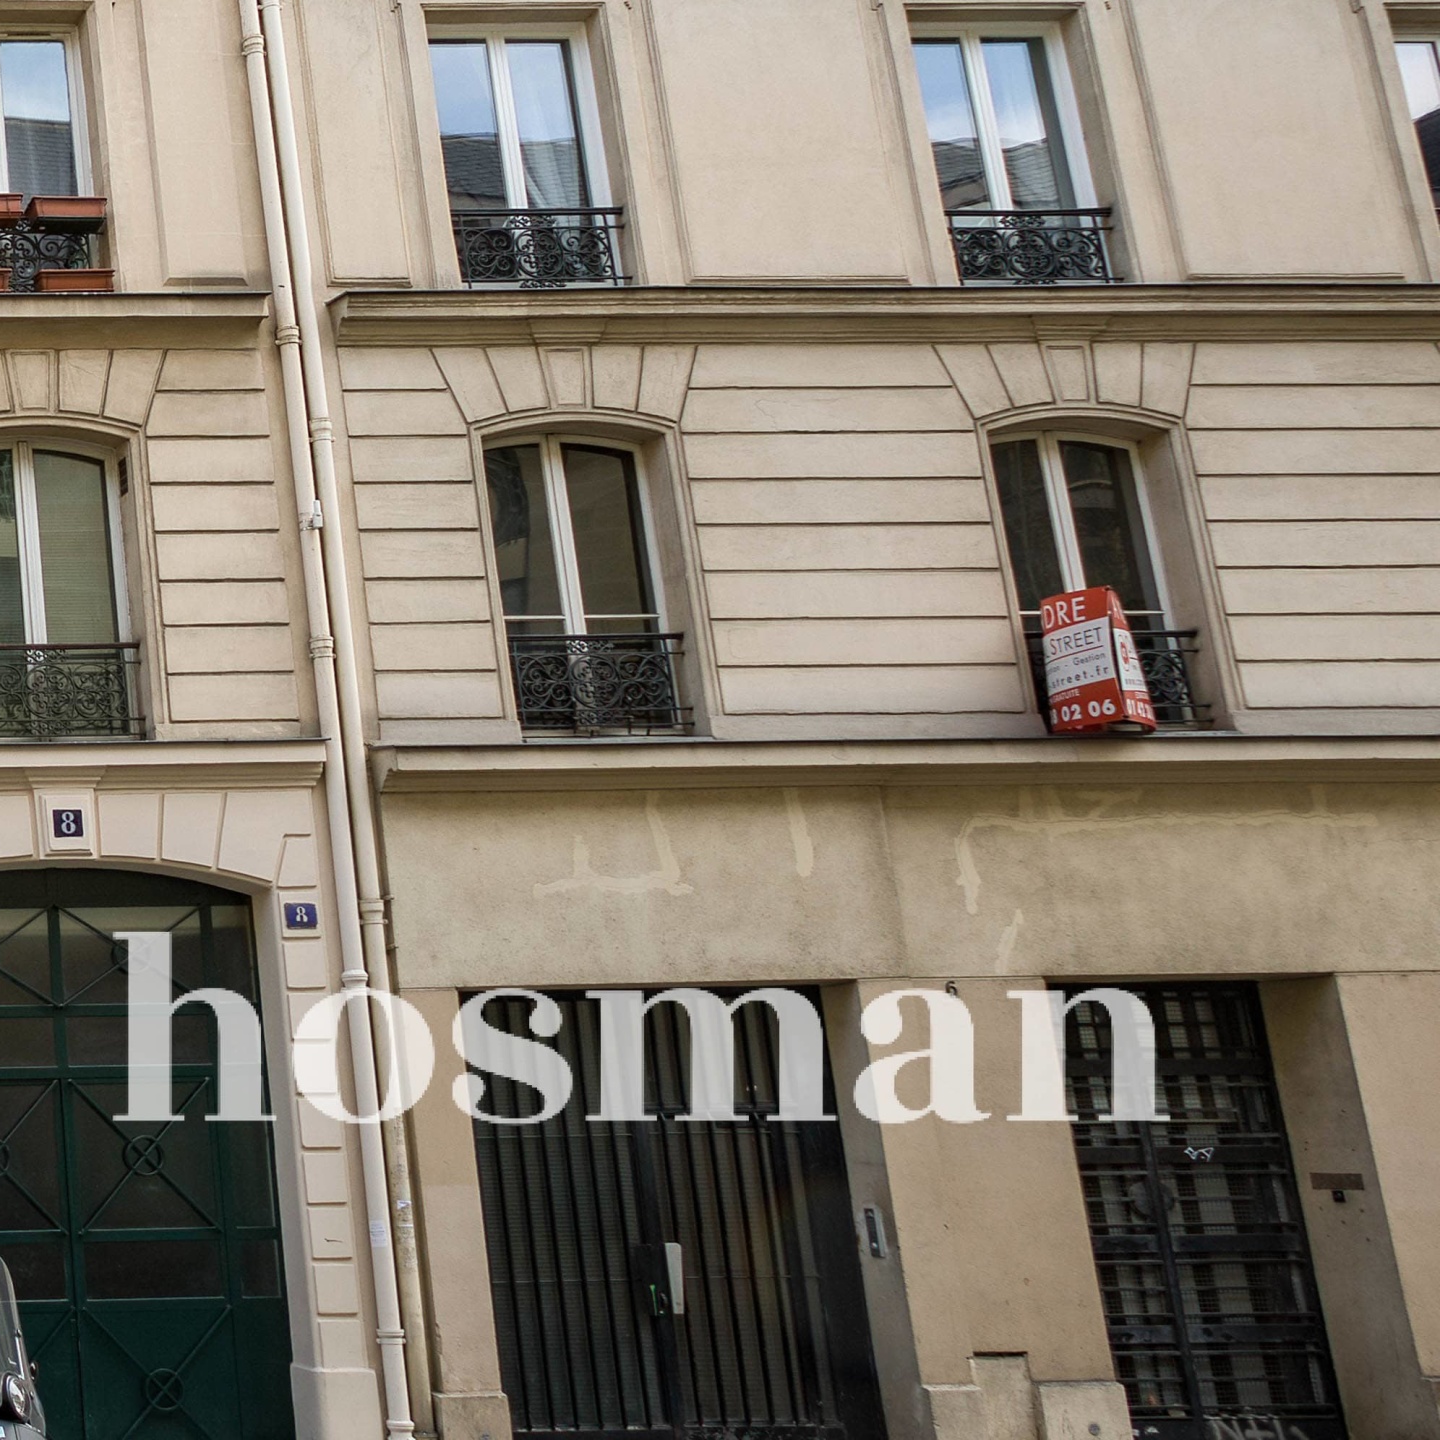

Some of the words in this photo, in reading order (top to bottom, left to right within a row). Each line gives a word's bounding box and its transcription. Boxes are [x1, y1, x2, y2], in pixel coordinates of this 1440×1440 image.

[1050, 626, 1102, 656] STREET
[1073, 652, 1106, 666] Gestion
[1061, 704, 1082, 722] 02
[1088, 698, 1115, 717] 06
[61, 811, 77, 835] 8
[945, 980, 958, 997] 6
